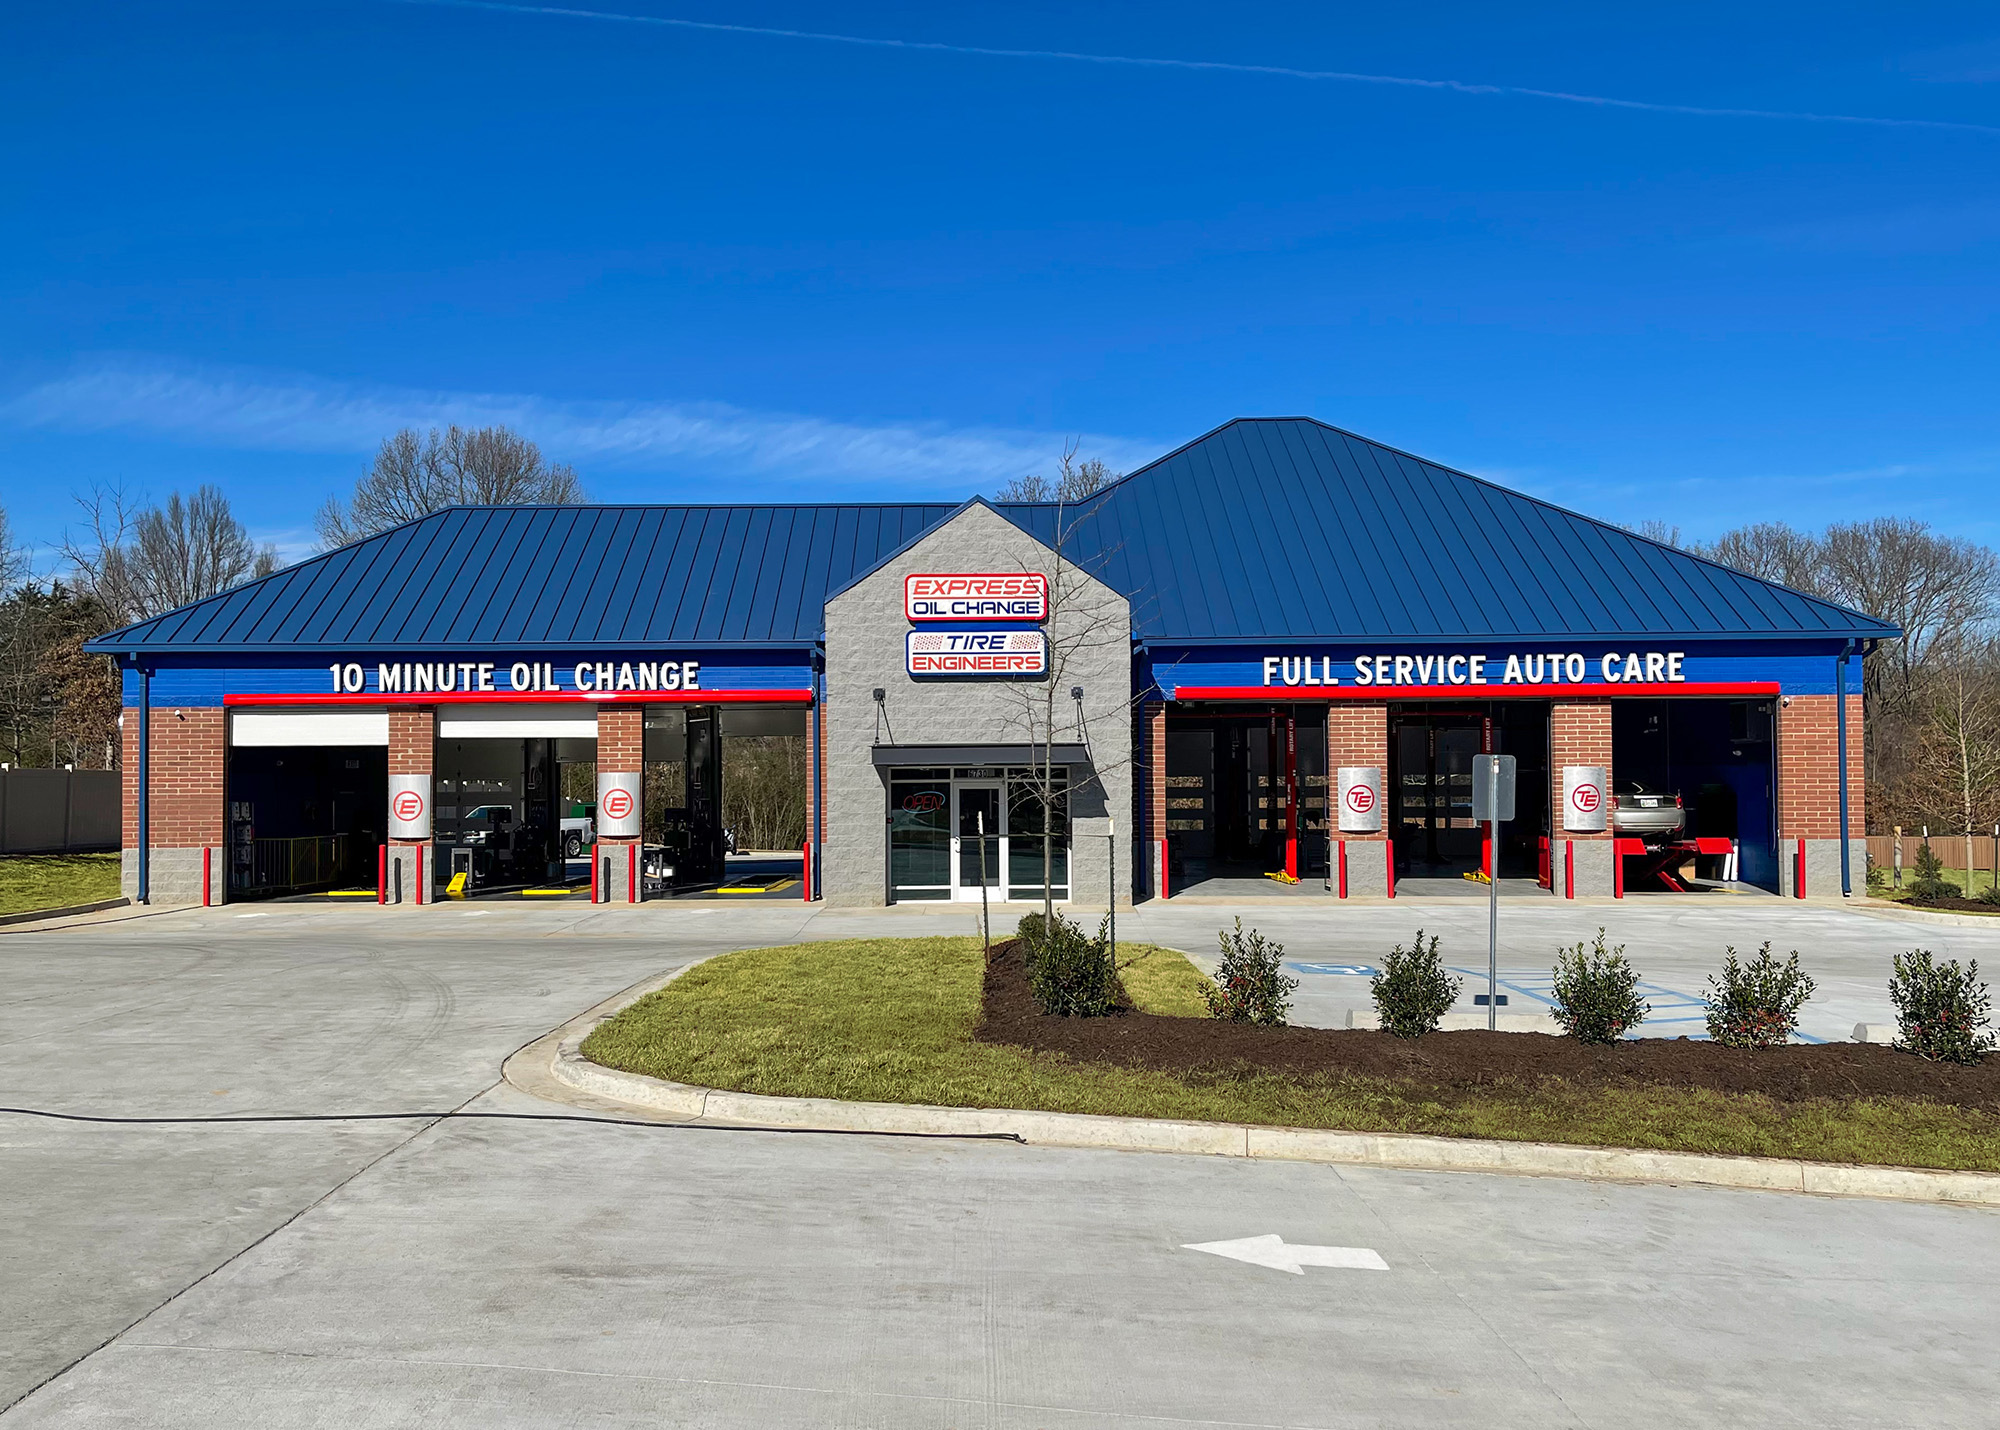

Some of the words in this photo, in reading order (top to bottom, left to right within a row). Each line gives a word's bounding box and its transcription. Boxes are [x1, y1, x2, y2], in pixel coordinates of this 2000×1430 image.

[913, 579, 1040, 595] EXPRESS
[913, 602, 947, 615] OIL
[951, 602, 1040, 615] CHANGE
[947, 635, 1007, 650] TIRE
[913, 656, 1041, 670] ENGINEERS
[1263, 656, 1339, 686] FULL
[1354, 654, 1487, 685] SERVICE
[1502, 653, 1586, 684] AUTO
[1601, 652, 1686, 682] CARE
[330, 663, 364, 693] 10
[378, 662, 495, 692] MINUTE
[510, 662, 560, 691] OIL
[574, 661, 699, 691] CHANGE
[609, 797, 628, 812] E
[904, 795, 943, 810] OPEN
[1351, 792, 1371, 807] TE
[1577, 791, 1597, 806] TE
[399, 799, 418, 814] E
